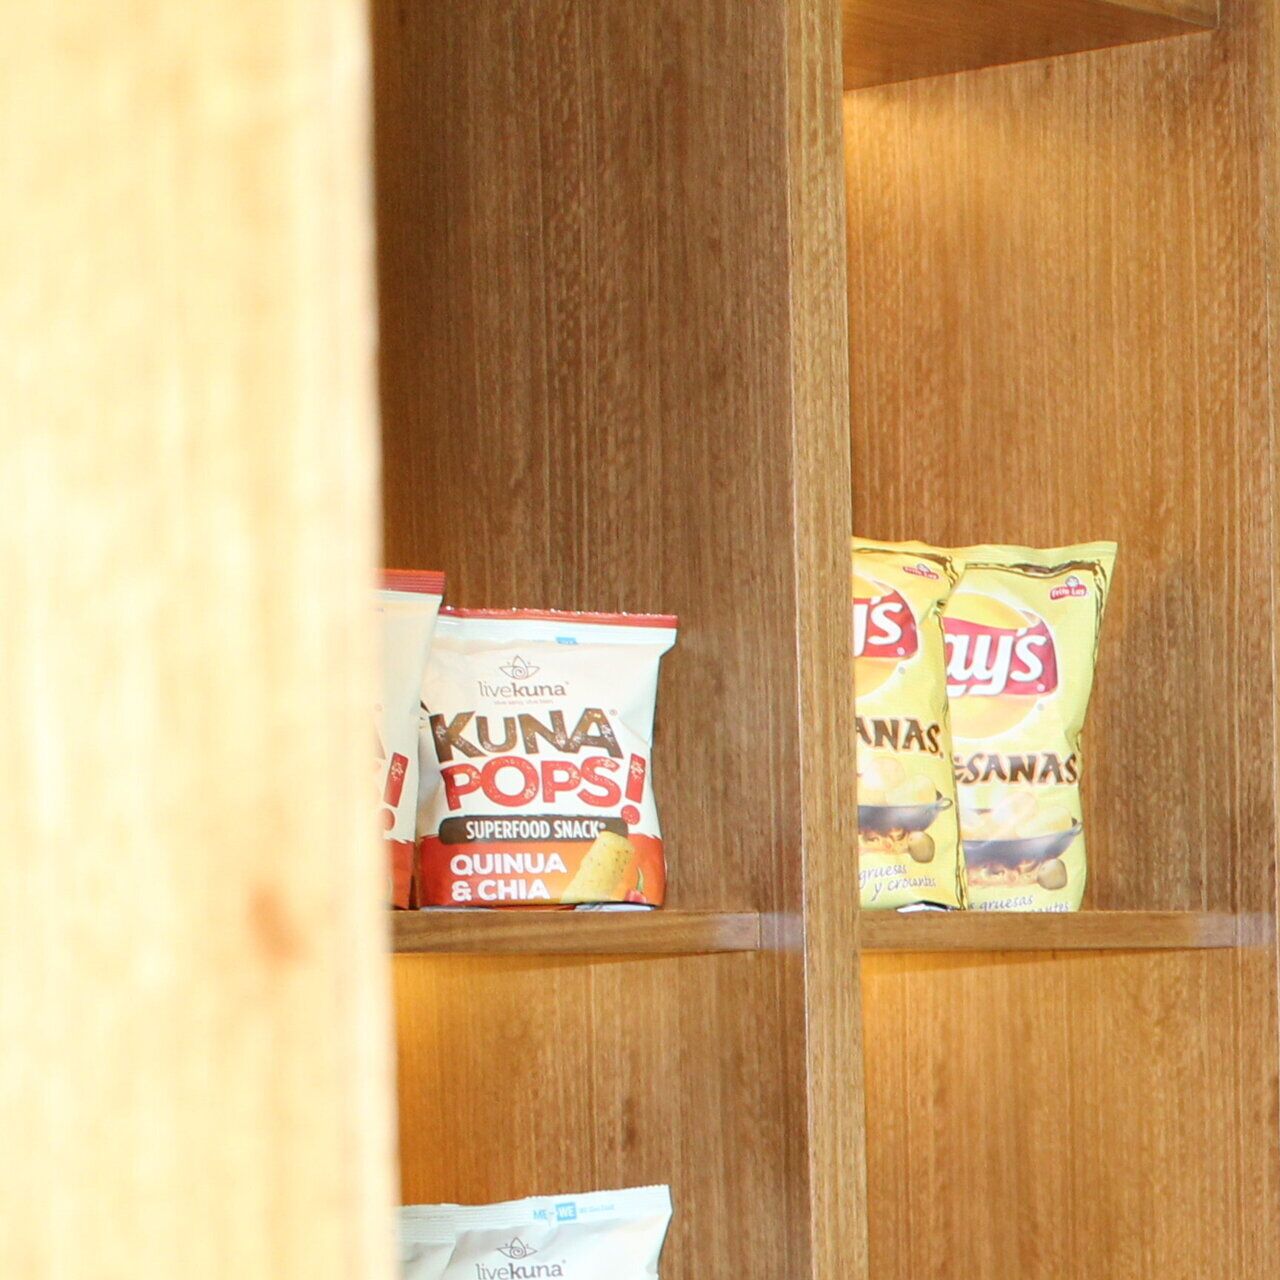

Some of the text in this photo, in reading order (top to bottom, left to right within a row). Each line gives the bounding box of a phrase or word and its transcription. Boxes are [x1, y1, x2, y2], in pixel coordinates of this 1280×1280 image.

[478, 680, 568, 698] livekuna
[429, 707, 624, 764] KUNA
[440, 752, 647, 826] POPS!
[466, 820, 601, 840] SUPERFOOD SNACK
[450, 852, 568, 877] QUINUA
[451, 879, 551, 902] & CHIA
[475, 1262, 564, 1280] livekuna
